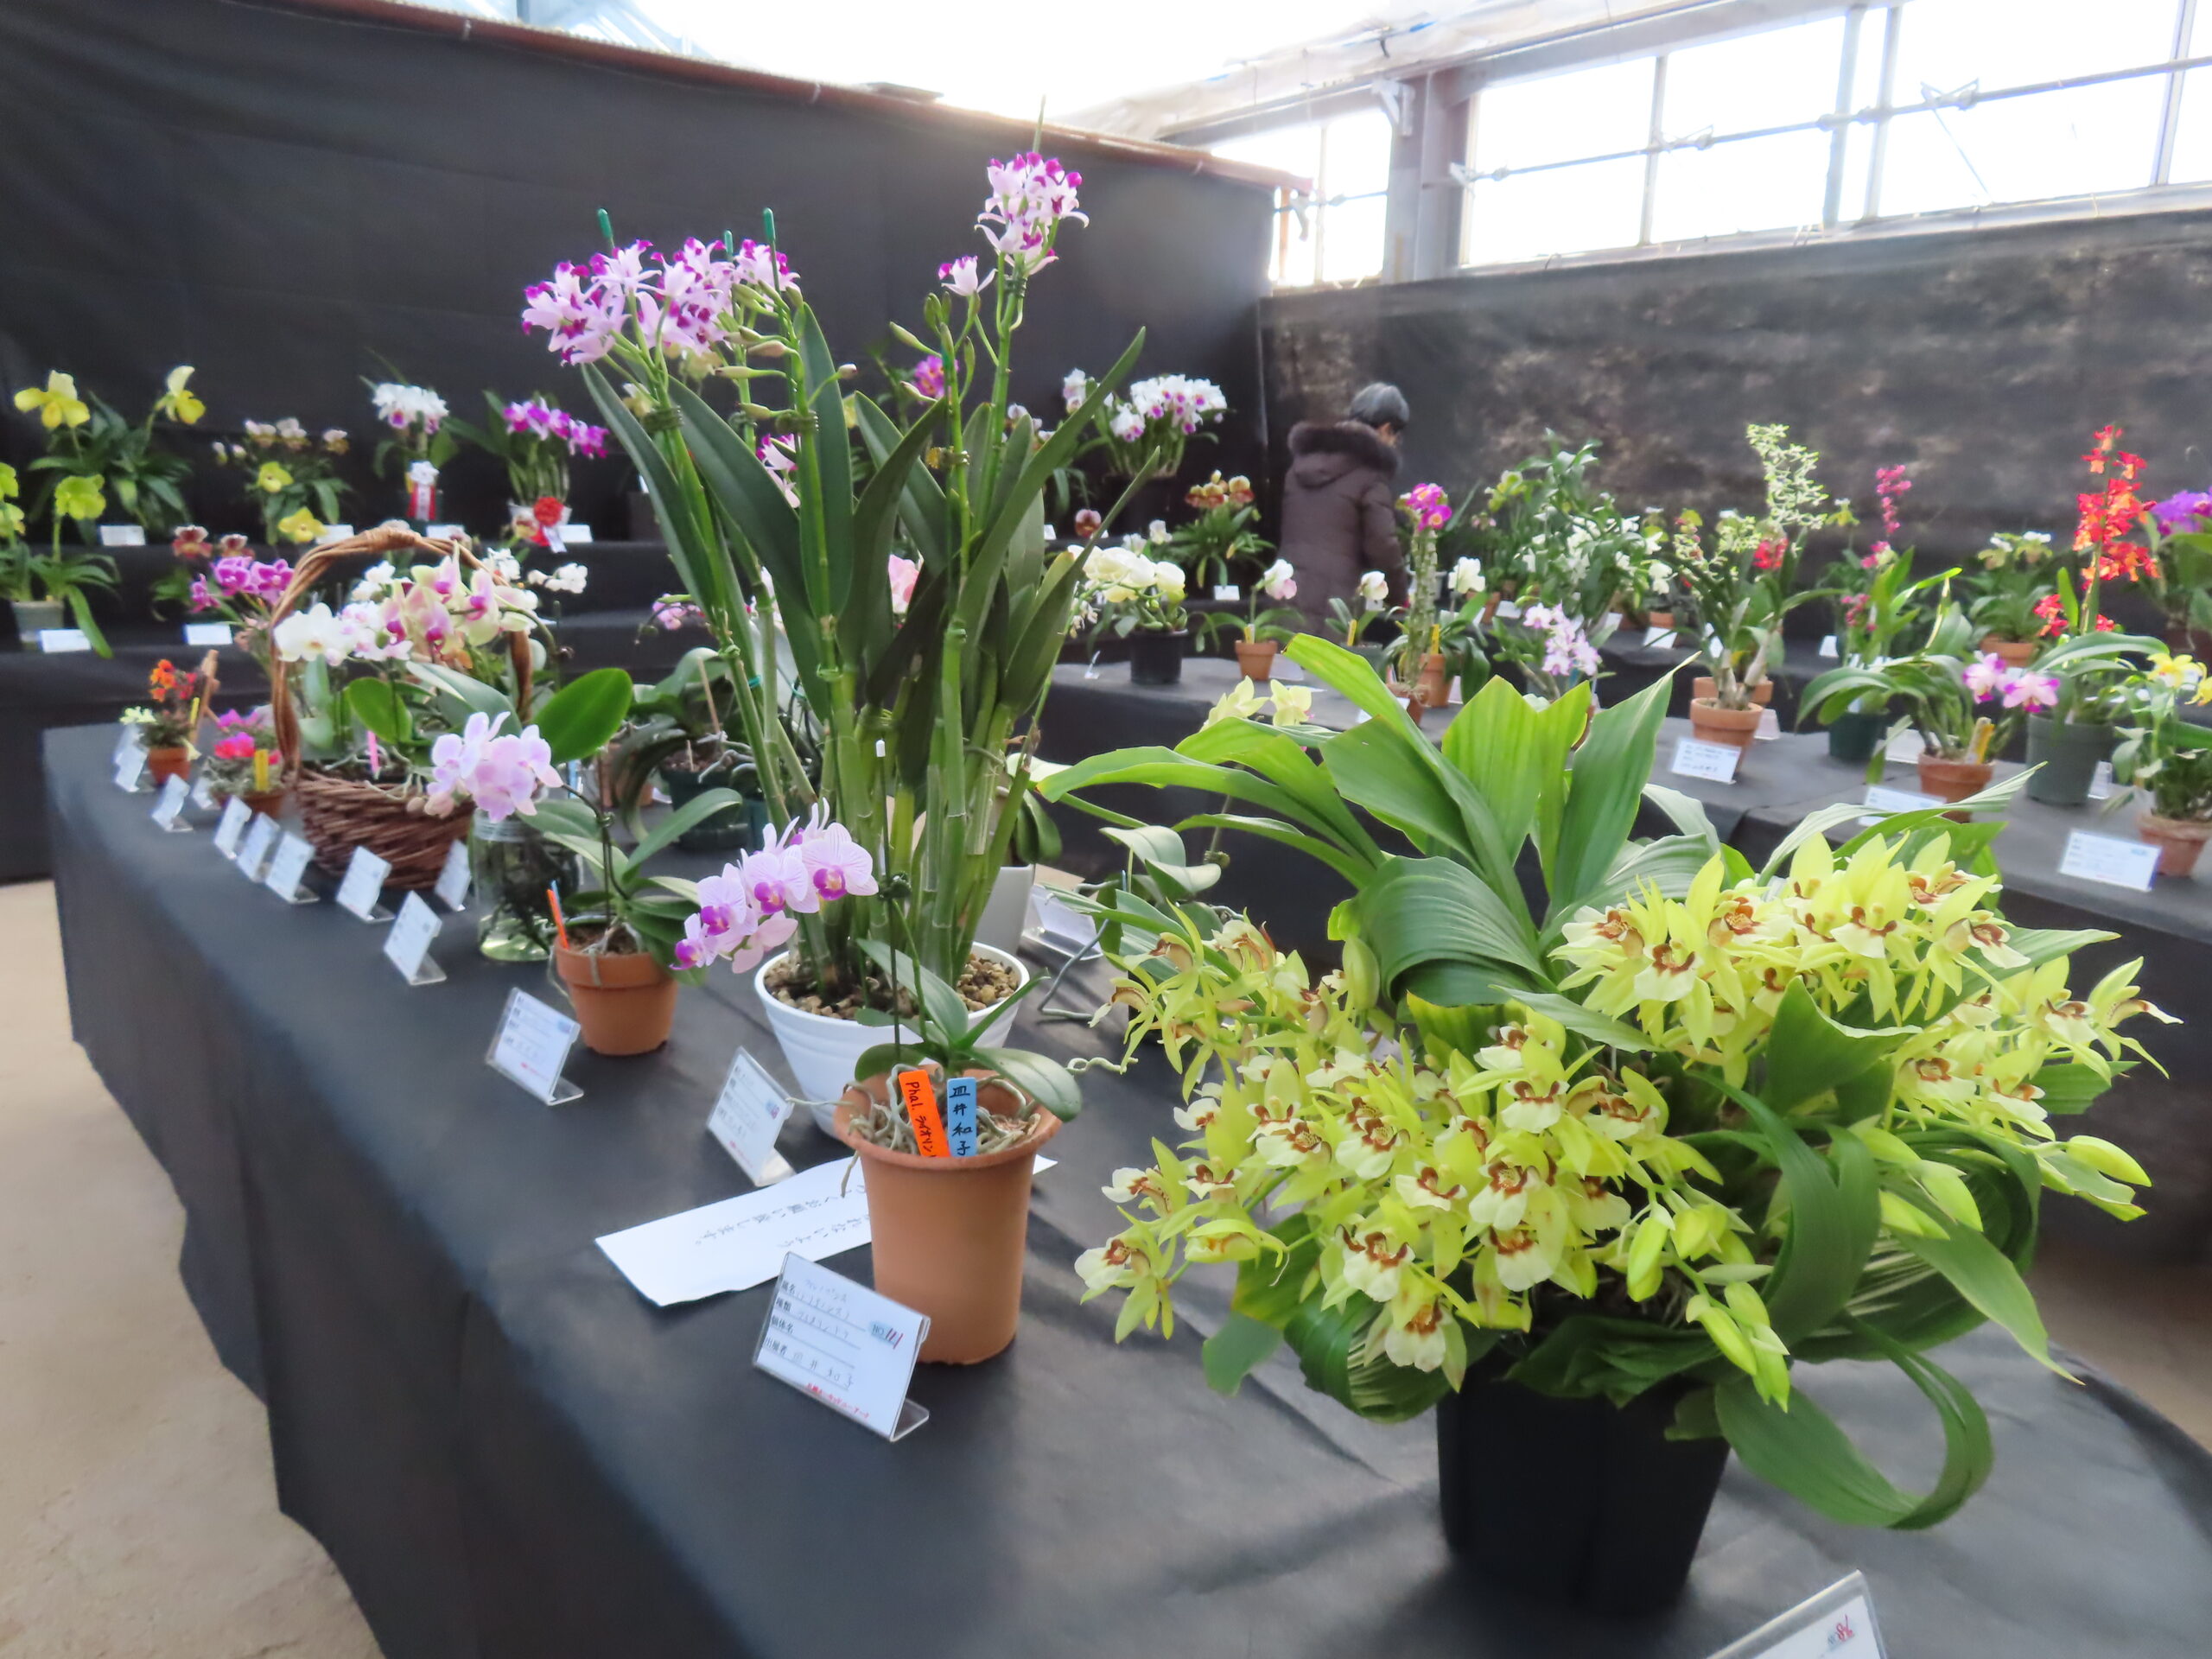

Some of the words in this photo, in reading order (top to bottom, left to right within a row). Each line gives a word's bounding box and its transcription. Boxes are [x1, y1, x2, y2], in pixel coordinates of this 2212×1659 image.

[906, 1081, 924, 1111] Phal.
[915, 1115, 937, 1157] ライオリン
